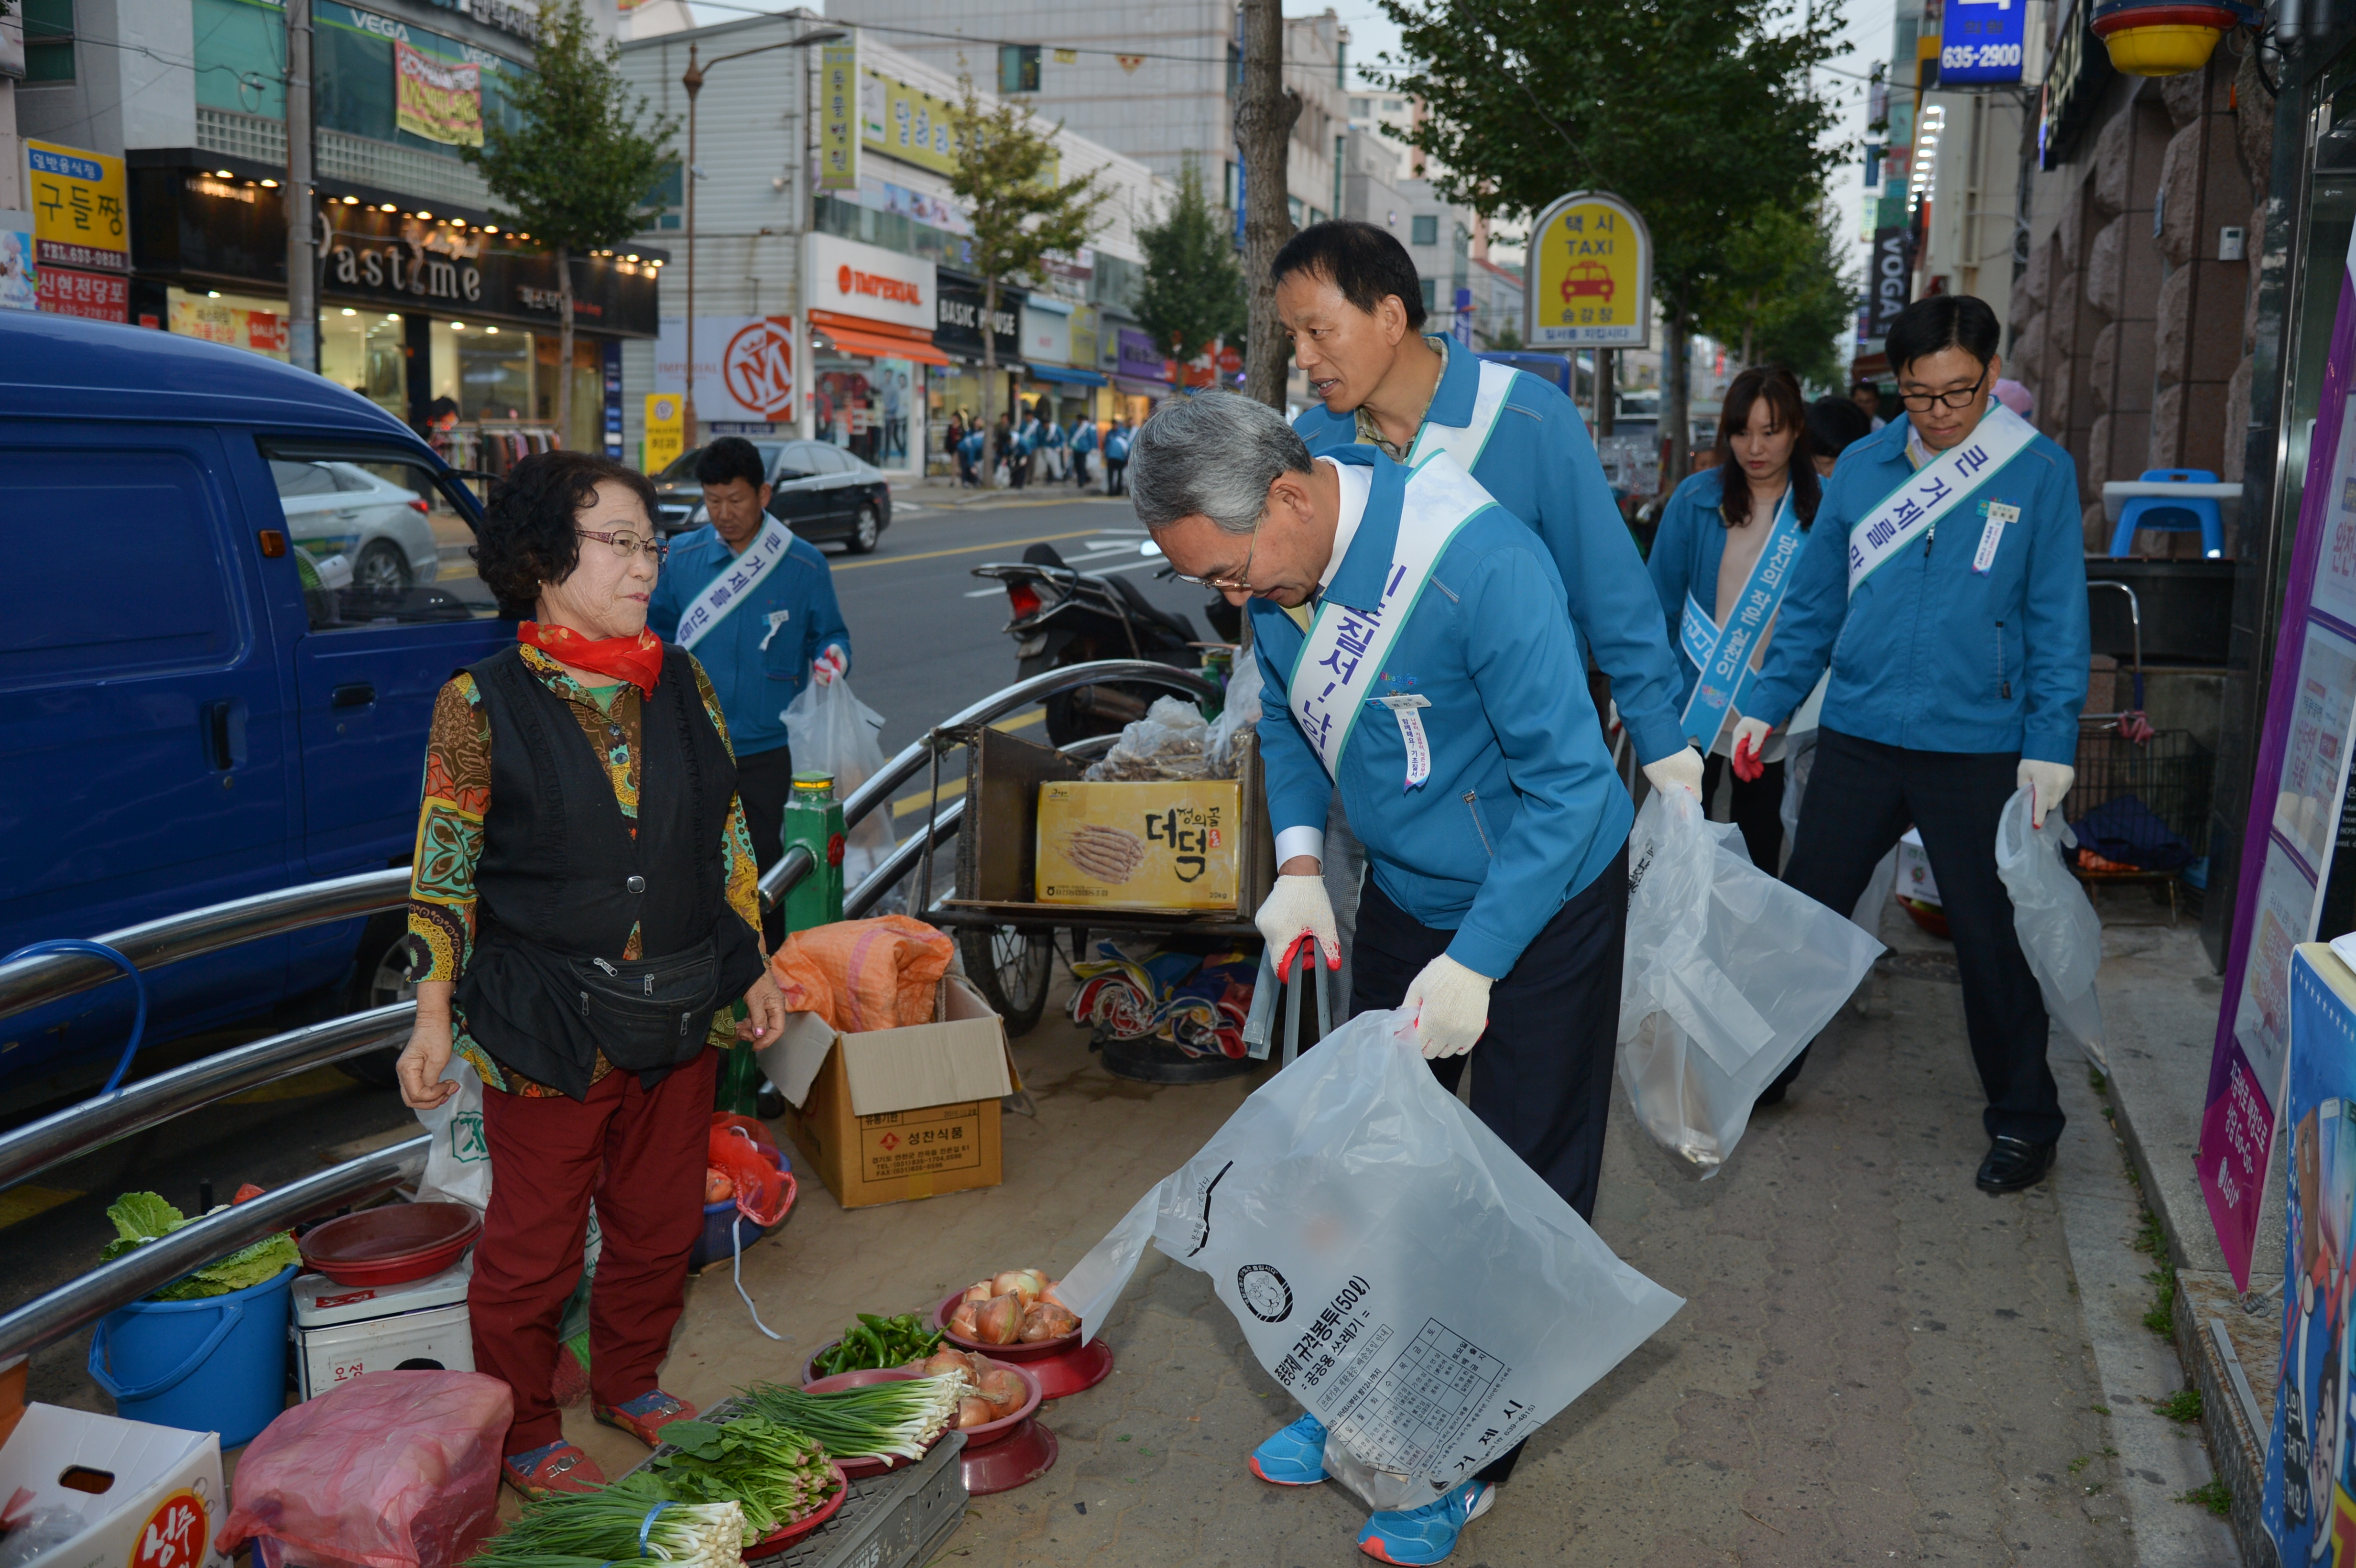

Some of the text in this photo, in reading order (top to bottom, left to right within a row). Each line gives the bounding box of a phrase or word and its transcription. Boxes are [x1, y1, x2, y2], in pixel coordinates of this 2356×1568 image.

[350, 8, 410, 43] VEGA
[1942, 43, 2021, 68] 635-2900
[33, 153, 95, 179] 일반음식점
[39, 183, 122, 236] 구들짱
[1565, 214, 1614, 233] 택시
[1565, 240, 1614, 255] TAXI
[39, 273, 125, 304] 신현전당포
[854, 271, 922, 306] IMPERIAL
[1879, 237, 1905, 319] VOGA
[938, 299, 1015, 336] BASIC HUSE
[658, 362, 717, 375] IMPEIAL
[1402, 718, 1415, 749] 함께해요!
[1145, 809, 1206, 883] 더덕
[908, 1126, 963, 1145] 성찬식품
[2225, 1102, 2237, 1143] 상담
[1304, 1318, 1364, 1385] 공공용 쓰레기
[1451, 1340, 1468, 1360] 토요일
[1470, 1353, 1486, 1372] 금지
[1274, 1353, 1303, 1386] 종량제
[1321, 1328, 1389, 1410] 쓰레기와 재활용품 배출요일 안내
[1345, 1425, 1353, 1433] 일
[1356, 1412, 1365, 1421] 월
[1370, 1396, 1379, 1405] 화
[1412, 1345, 1422, 1354] 금
[1427, 1328, 1435, 1336] 토
[1337, 1393, 1360, 1418] 저녁8시부터
[1357, 1368, 1382, 1396] 밤12시까지
